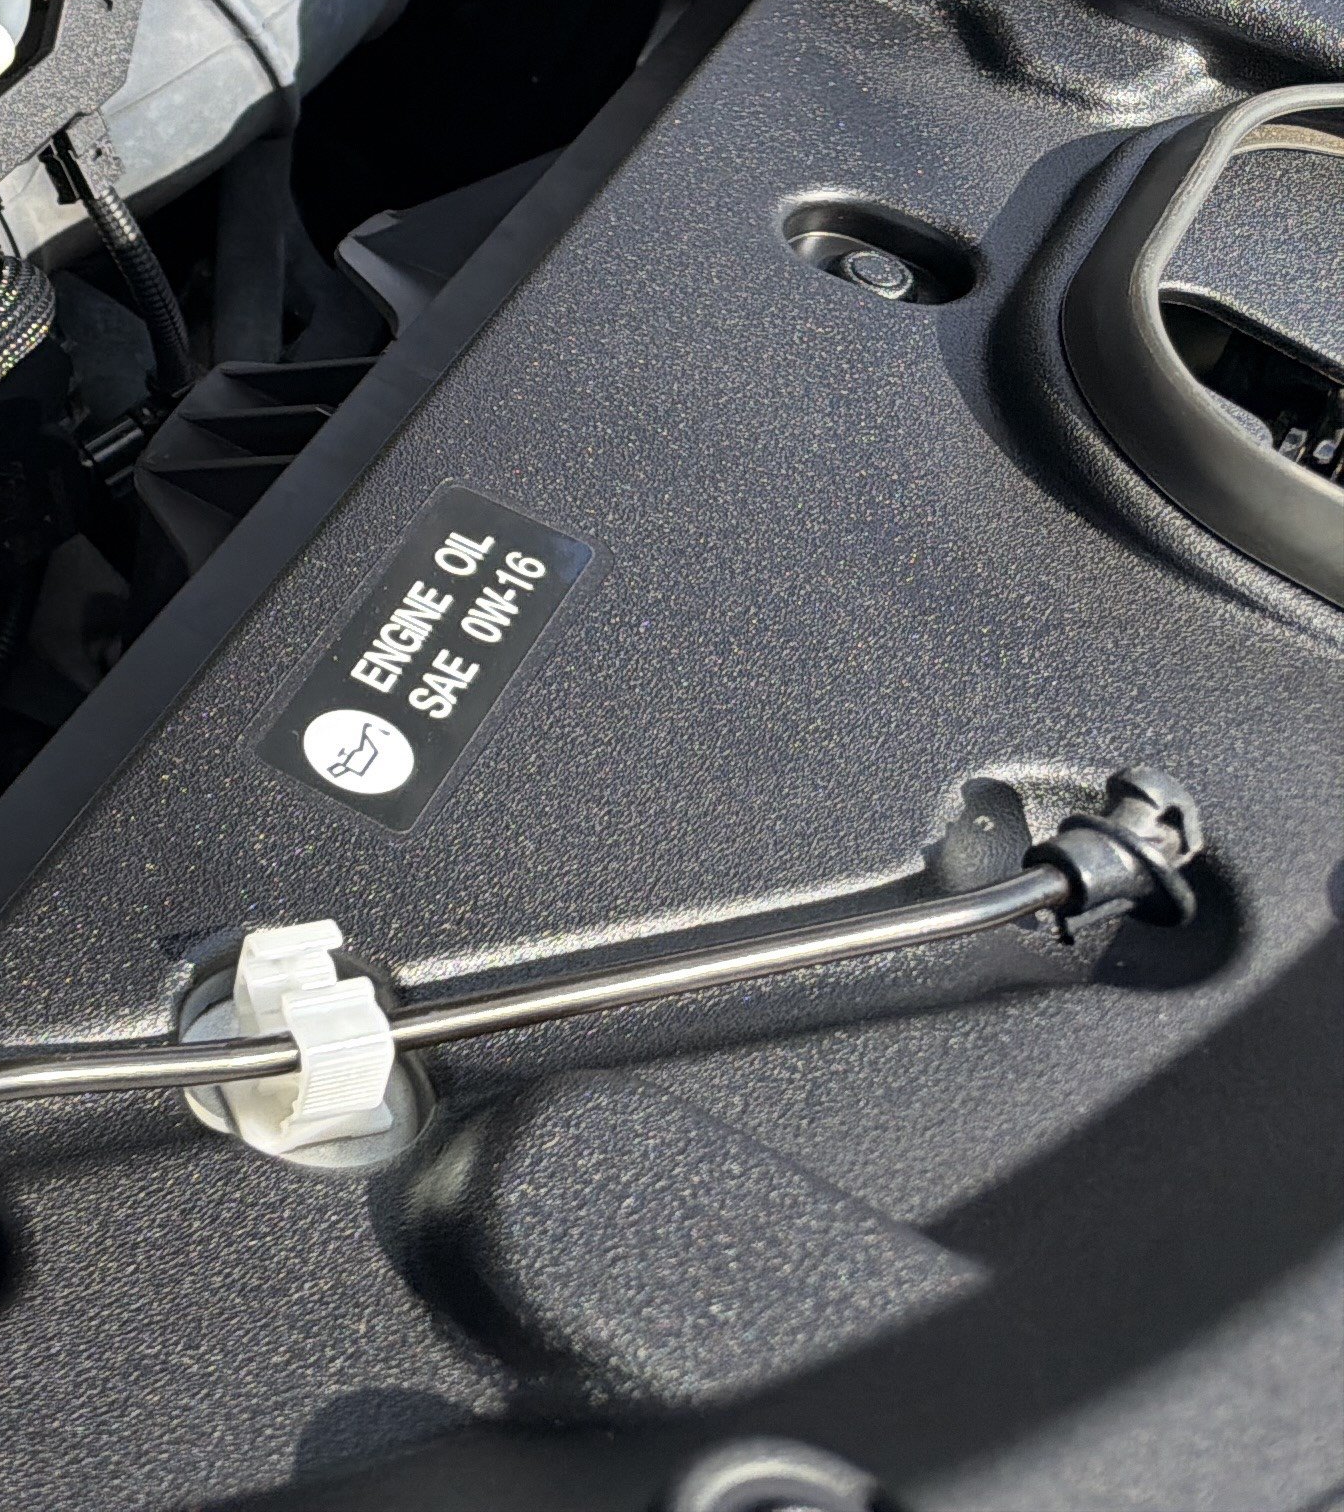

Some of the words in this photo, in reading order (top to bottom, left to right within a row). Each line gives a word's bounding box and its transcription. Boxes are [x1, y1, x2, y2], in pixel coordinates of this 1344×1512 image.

[349, 580, 455, 694] ENGINE
[434, 531, 496, 578] OIL
[408, 650, 480, 720] SAE
[460, 550, 547, 644] 0W-16
